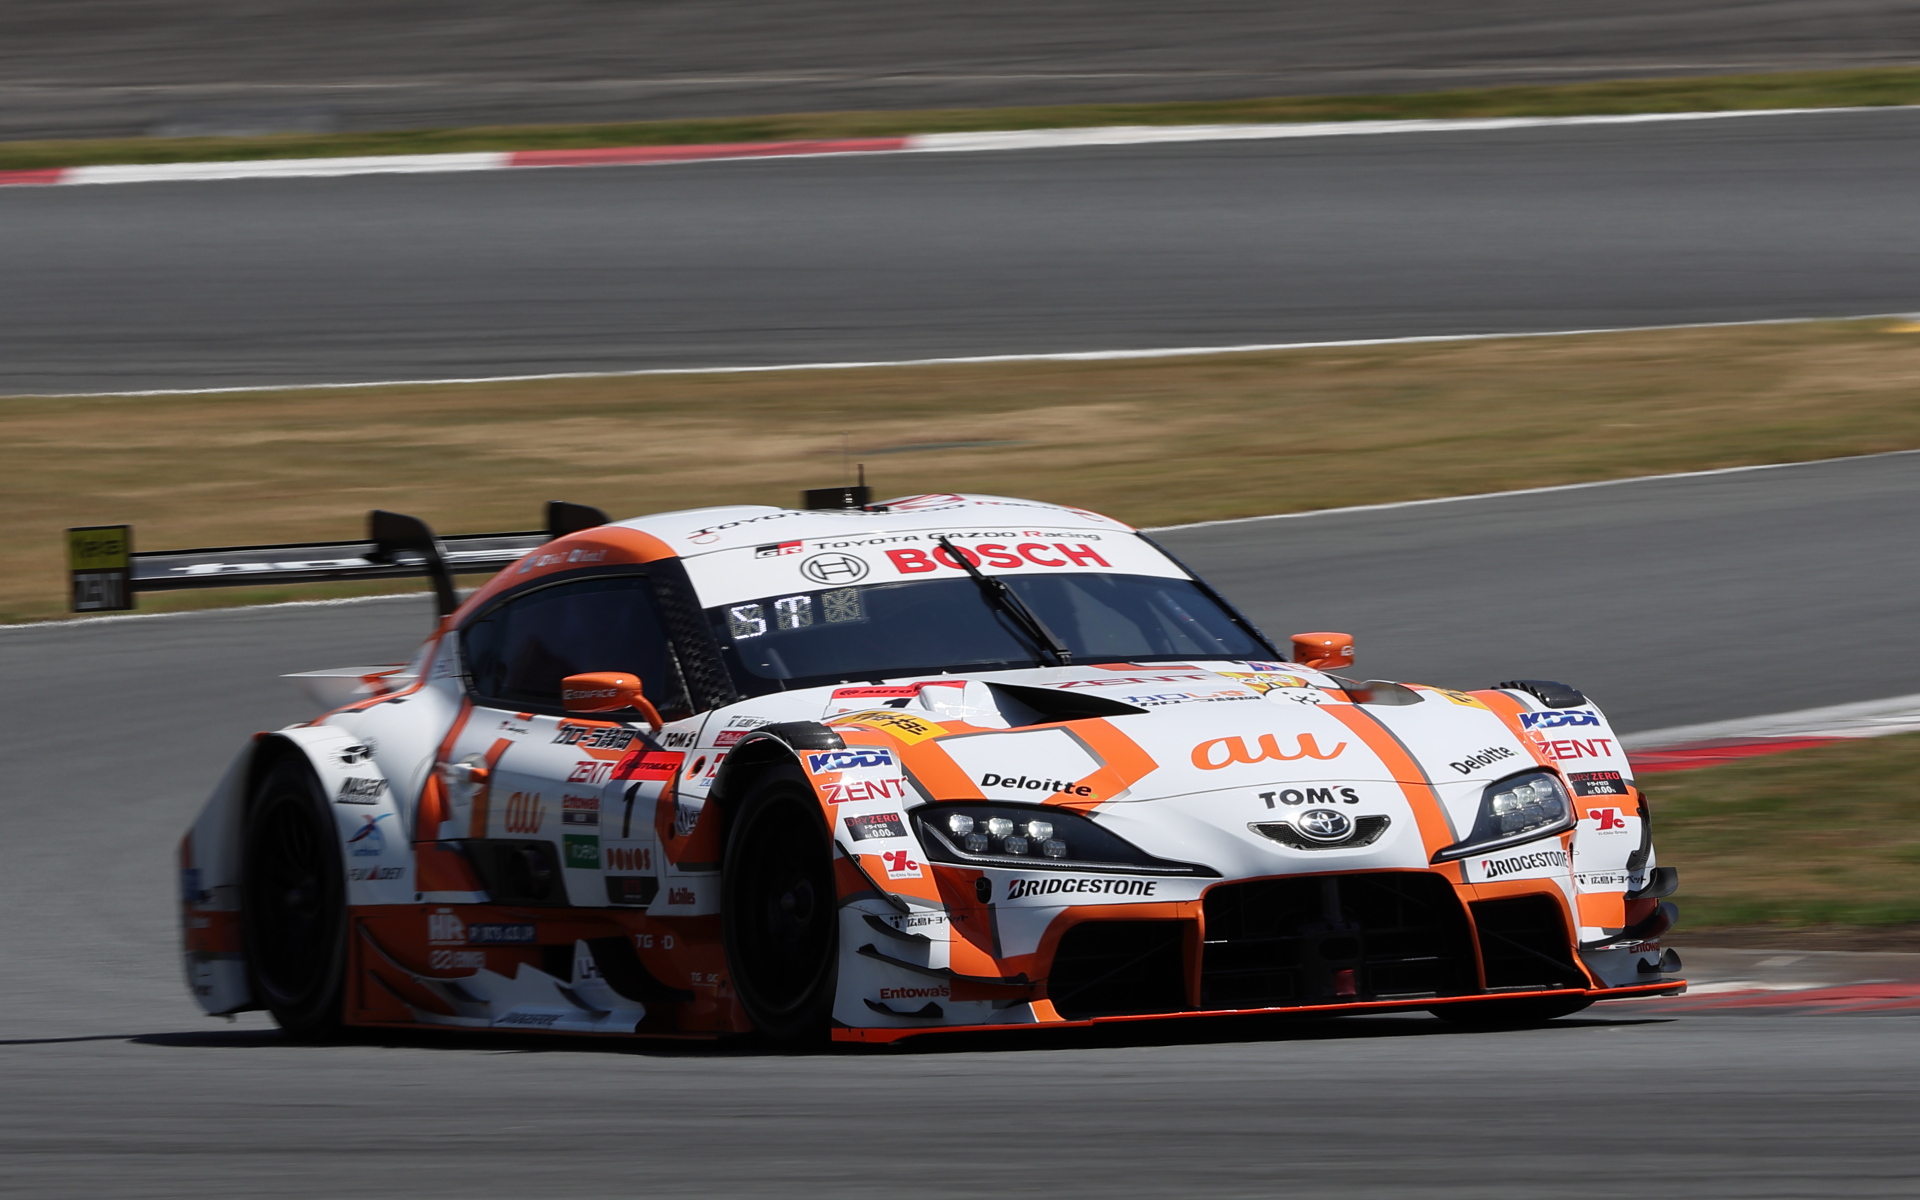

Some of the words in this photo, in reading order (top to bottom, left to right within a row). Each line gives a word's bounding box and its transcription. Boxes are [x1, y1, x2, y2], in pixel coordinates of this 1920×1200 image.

[813, 535, 919, 549] TOYOTA
[926, 530, 1017, 543] GAZOO
[1022, 530, 1102, 542] Racing
[884, 543, 1114, 574] BOSCH
[1041, 674, 1209, 689] ZENT
[1518, 711, 1601, 730] KDDI
[662, 731, 697, 748] TOM'S
[1537, 738, 1613, 761] ZENT
[808, 750, 893, 775] KDDI
[1190, 733, 1348, 771] au
[567, 761, 618, 784] ZENT
[821, 776, 908, 806] ZENT
[1258, 785, 1360, 810] TOM'S
[504, 792, 546, 834] au
[621, 781, 643, 840] 1
[606, 848, 651, 871] PONOS
[1481, 850, 1569, 879] BRIDGESTONE
[1006, 878, 1158, 901] BRIDGESTONE
[879, 984, 950, 1000] Entowa's
